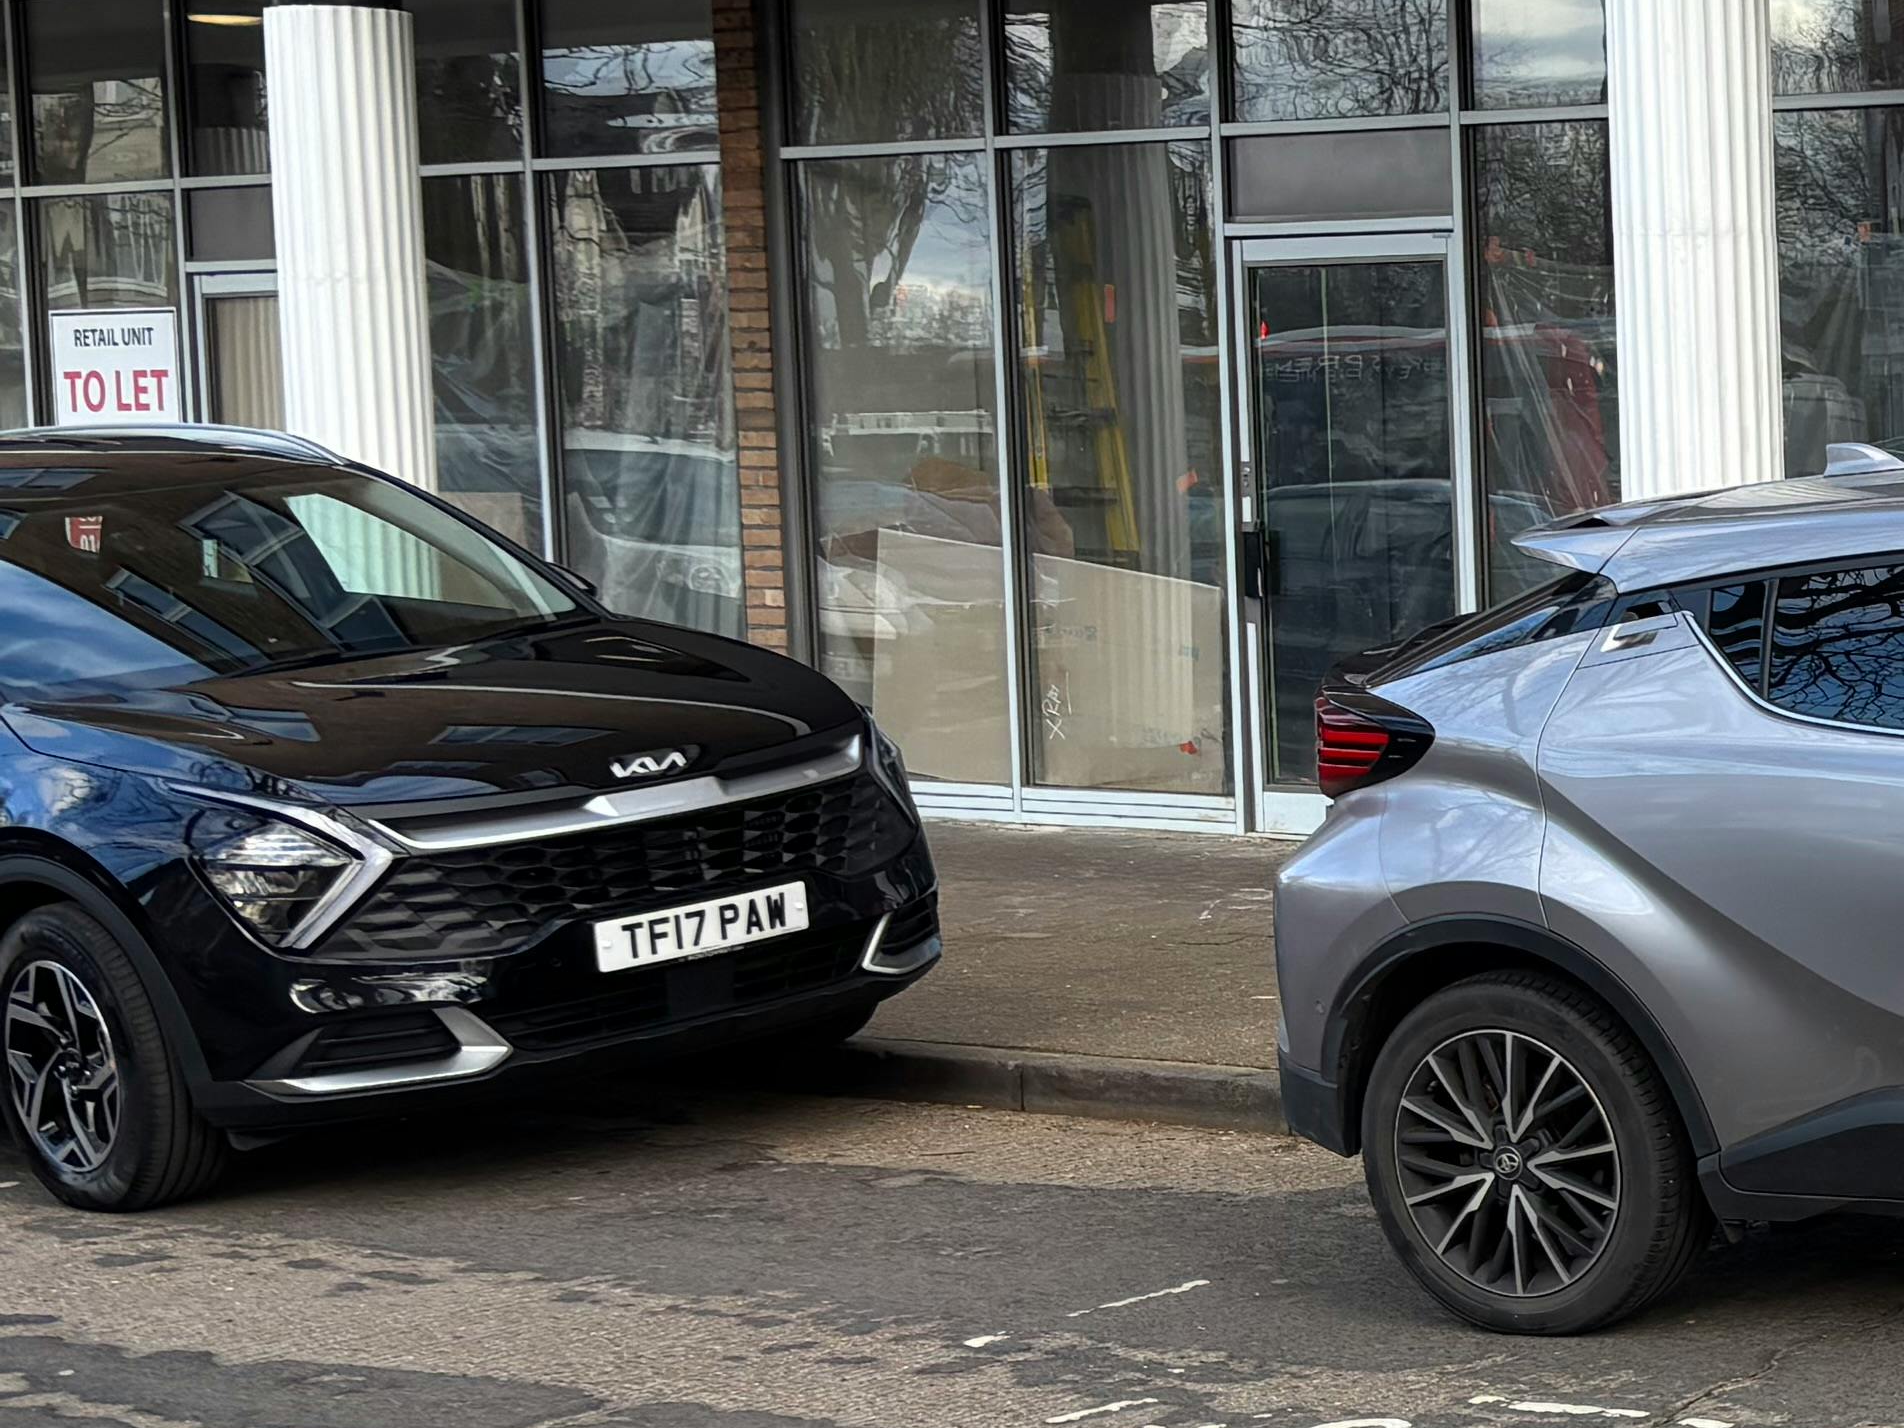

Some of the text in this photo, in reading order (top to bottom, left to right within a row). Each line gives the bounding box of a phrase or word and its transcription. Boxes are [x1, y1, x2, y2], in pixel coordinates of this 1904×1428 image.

[74, 327, 154, 347] RETAIL UNIT
[64, 369, 169, 412] TO LET
[610, 752, 688, 778] KIA
[621, 892, 786, 959] TF17 PAW
